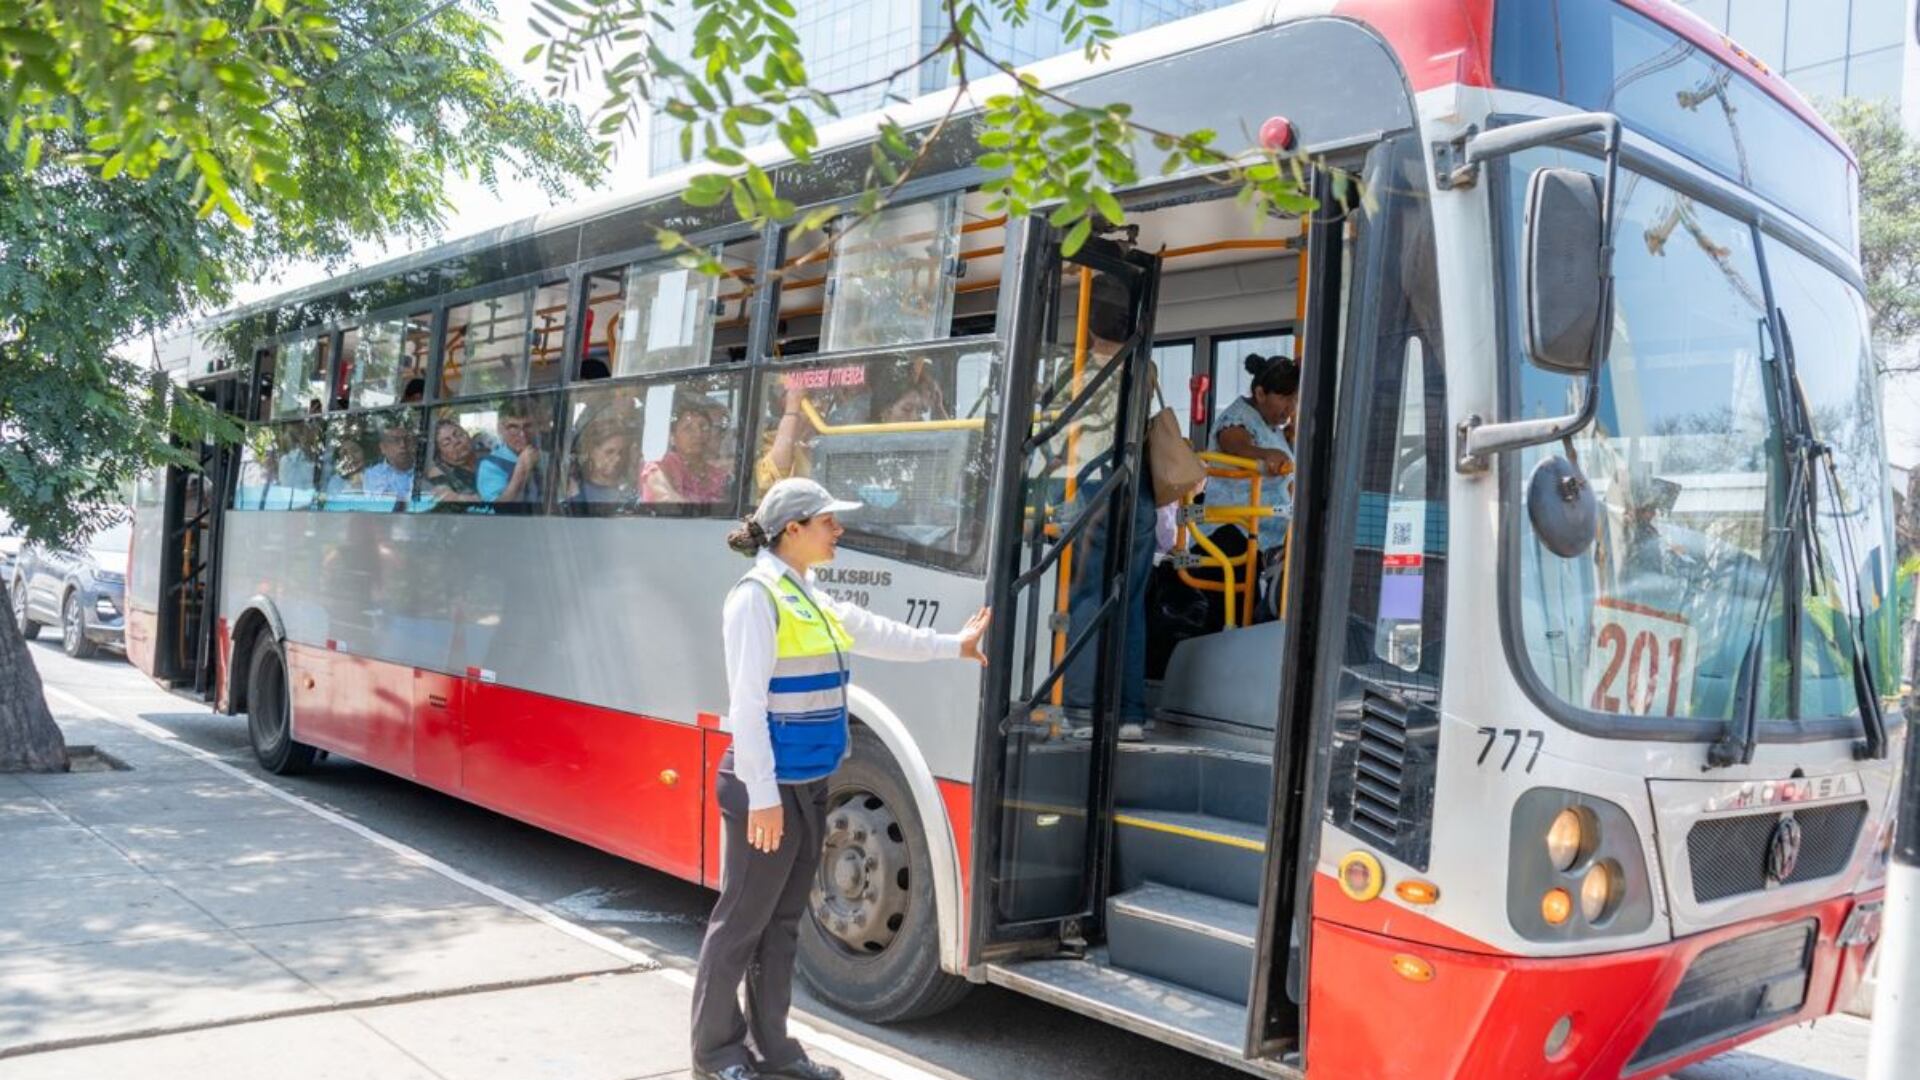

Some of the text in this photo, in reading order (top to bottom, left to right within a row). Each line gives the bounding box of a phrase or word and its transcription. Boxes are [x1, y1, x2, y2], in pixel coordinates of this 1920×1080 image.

[906, 598, 940, 629] 777
[1591, 622, 1683, 720] 201
[1477, 726, 1545, 774] 777
